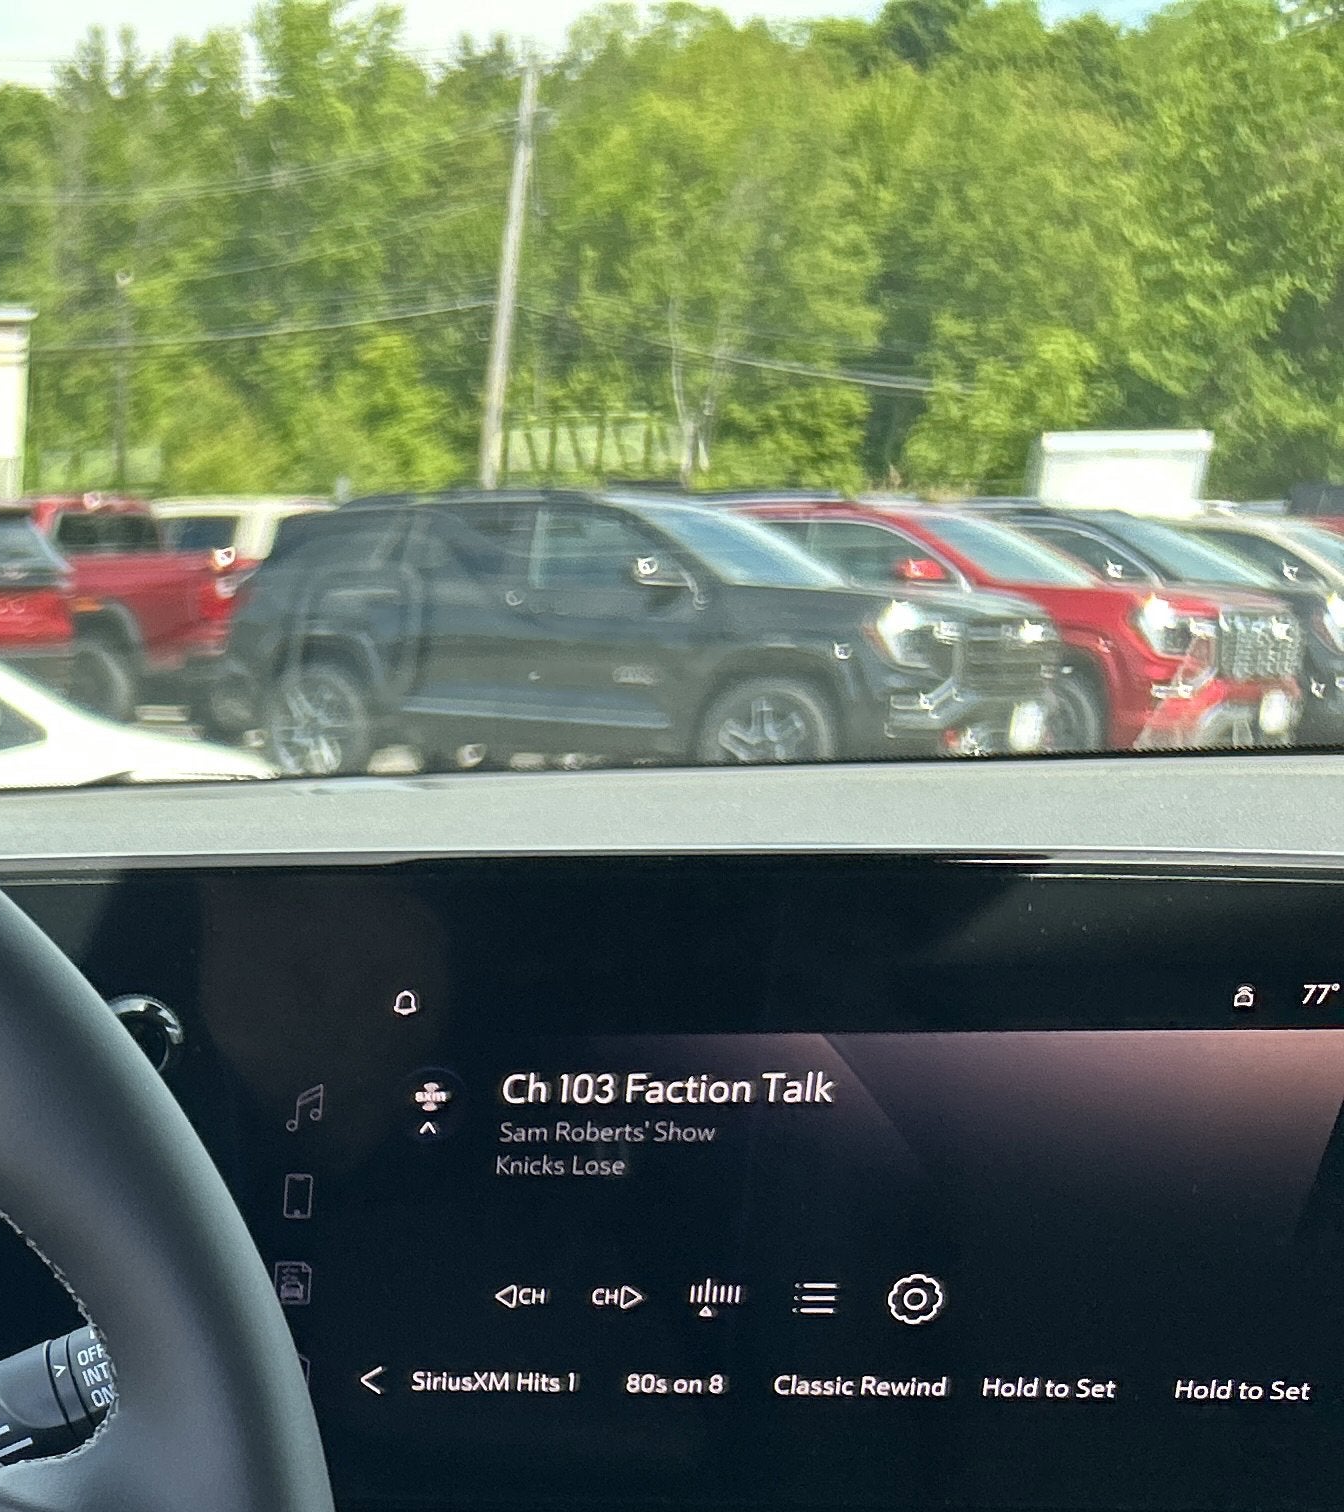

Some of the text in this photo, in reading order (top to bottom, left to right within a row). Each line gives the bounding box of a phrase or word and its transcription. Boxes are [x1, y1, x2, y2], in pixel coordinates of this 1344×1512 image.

[1301, 983, 1341, 1005] 77°
[502, 1070, 834, 1104] Ch 103 Faction Talk
[499, 1120, 716, 1143] Sam Roberts' Show
[496, 1154, 626, 1176] Knicks Lose
[518, 1287, 546, 1305] CH
[590, 1287, 619, 1305] CH
[77, 1343, 104, 1366] OFF
[81, 1361, 109, 1387] INT
[411, 1371, 510, 1392] SiriusXM
[516, 1371, 561, 1393] Hits
[626, 1373, 724, 1395] 80s on 8
[91, 1384, 115, 1408] ON
[773, 1374, 947, 1397] Classic Rewind
[982, 1376, 1117, 1399] Hold to Set
[1174, 1379, 1311, 1401] Hold to Set
